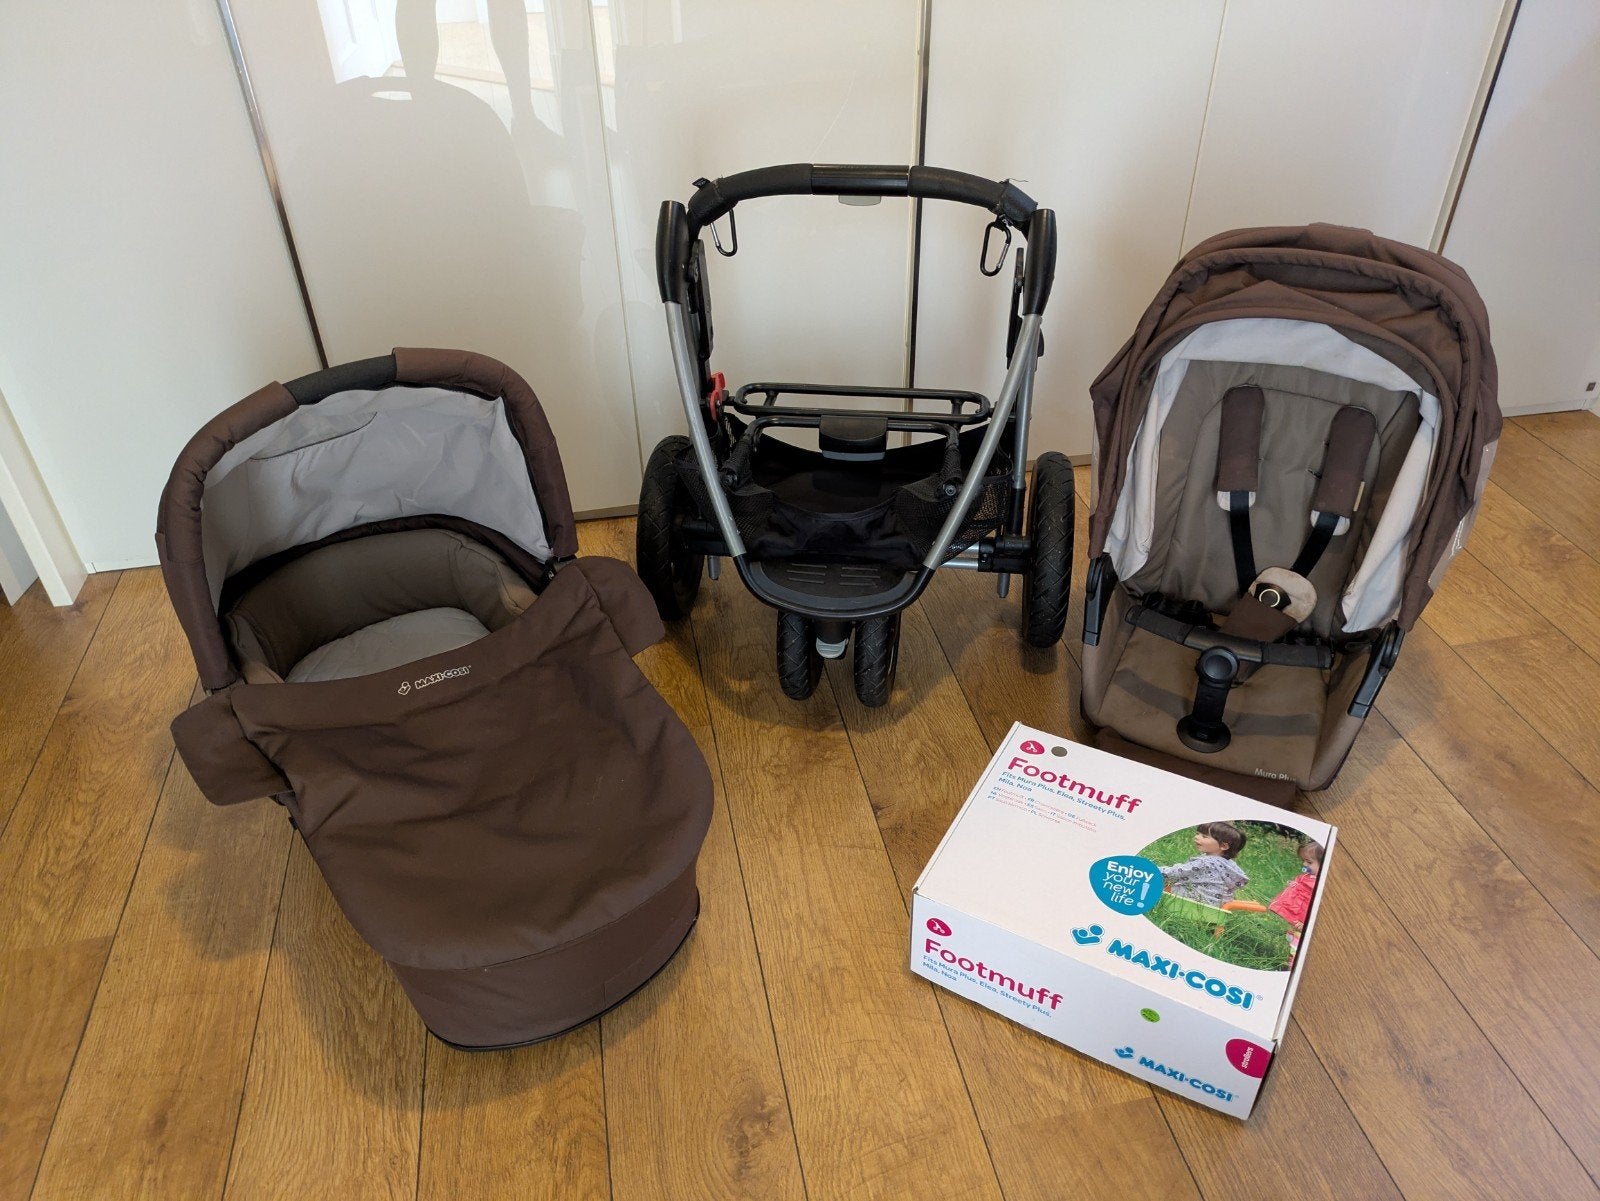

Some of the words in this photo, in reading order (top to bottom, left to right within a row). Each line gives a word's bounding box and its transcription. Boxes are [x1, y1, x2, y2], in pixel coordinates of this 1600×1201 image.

[1254, 768, 1277, 780] Mura
[1007, 756, 1143, 814] Footmuff
[1016, 782, 1033, 793] Noa
[1001, 771, 1017, 781] Fits
[1018, 776, 1037, 787] Mura
[1076, 797, 1106, 814] Streety
[1107, 808, 1127, 821] Plus,
[1102, 872, 1141, 887] your
[1106, 860, 1155, 883] Enjoy
[1103, 881, 1136, 896] new
[1110, 891, 1134, 906] life
[925, 938, 1064, 1010] Footmuff
[941, 970, 958, 982] Noa
[923, 955, 938, 966] Fits
[938, 960, 959, 976] Mura
[960, 971, 978, 985] Plus,
[1000, 991, 1031, 1009] Streety
[1032, 1004, 1052, 1018] Plus,
[1241, 1046, 1254, 1069] strollers
